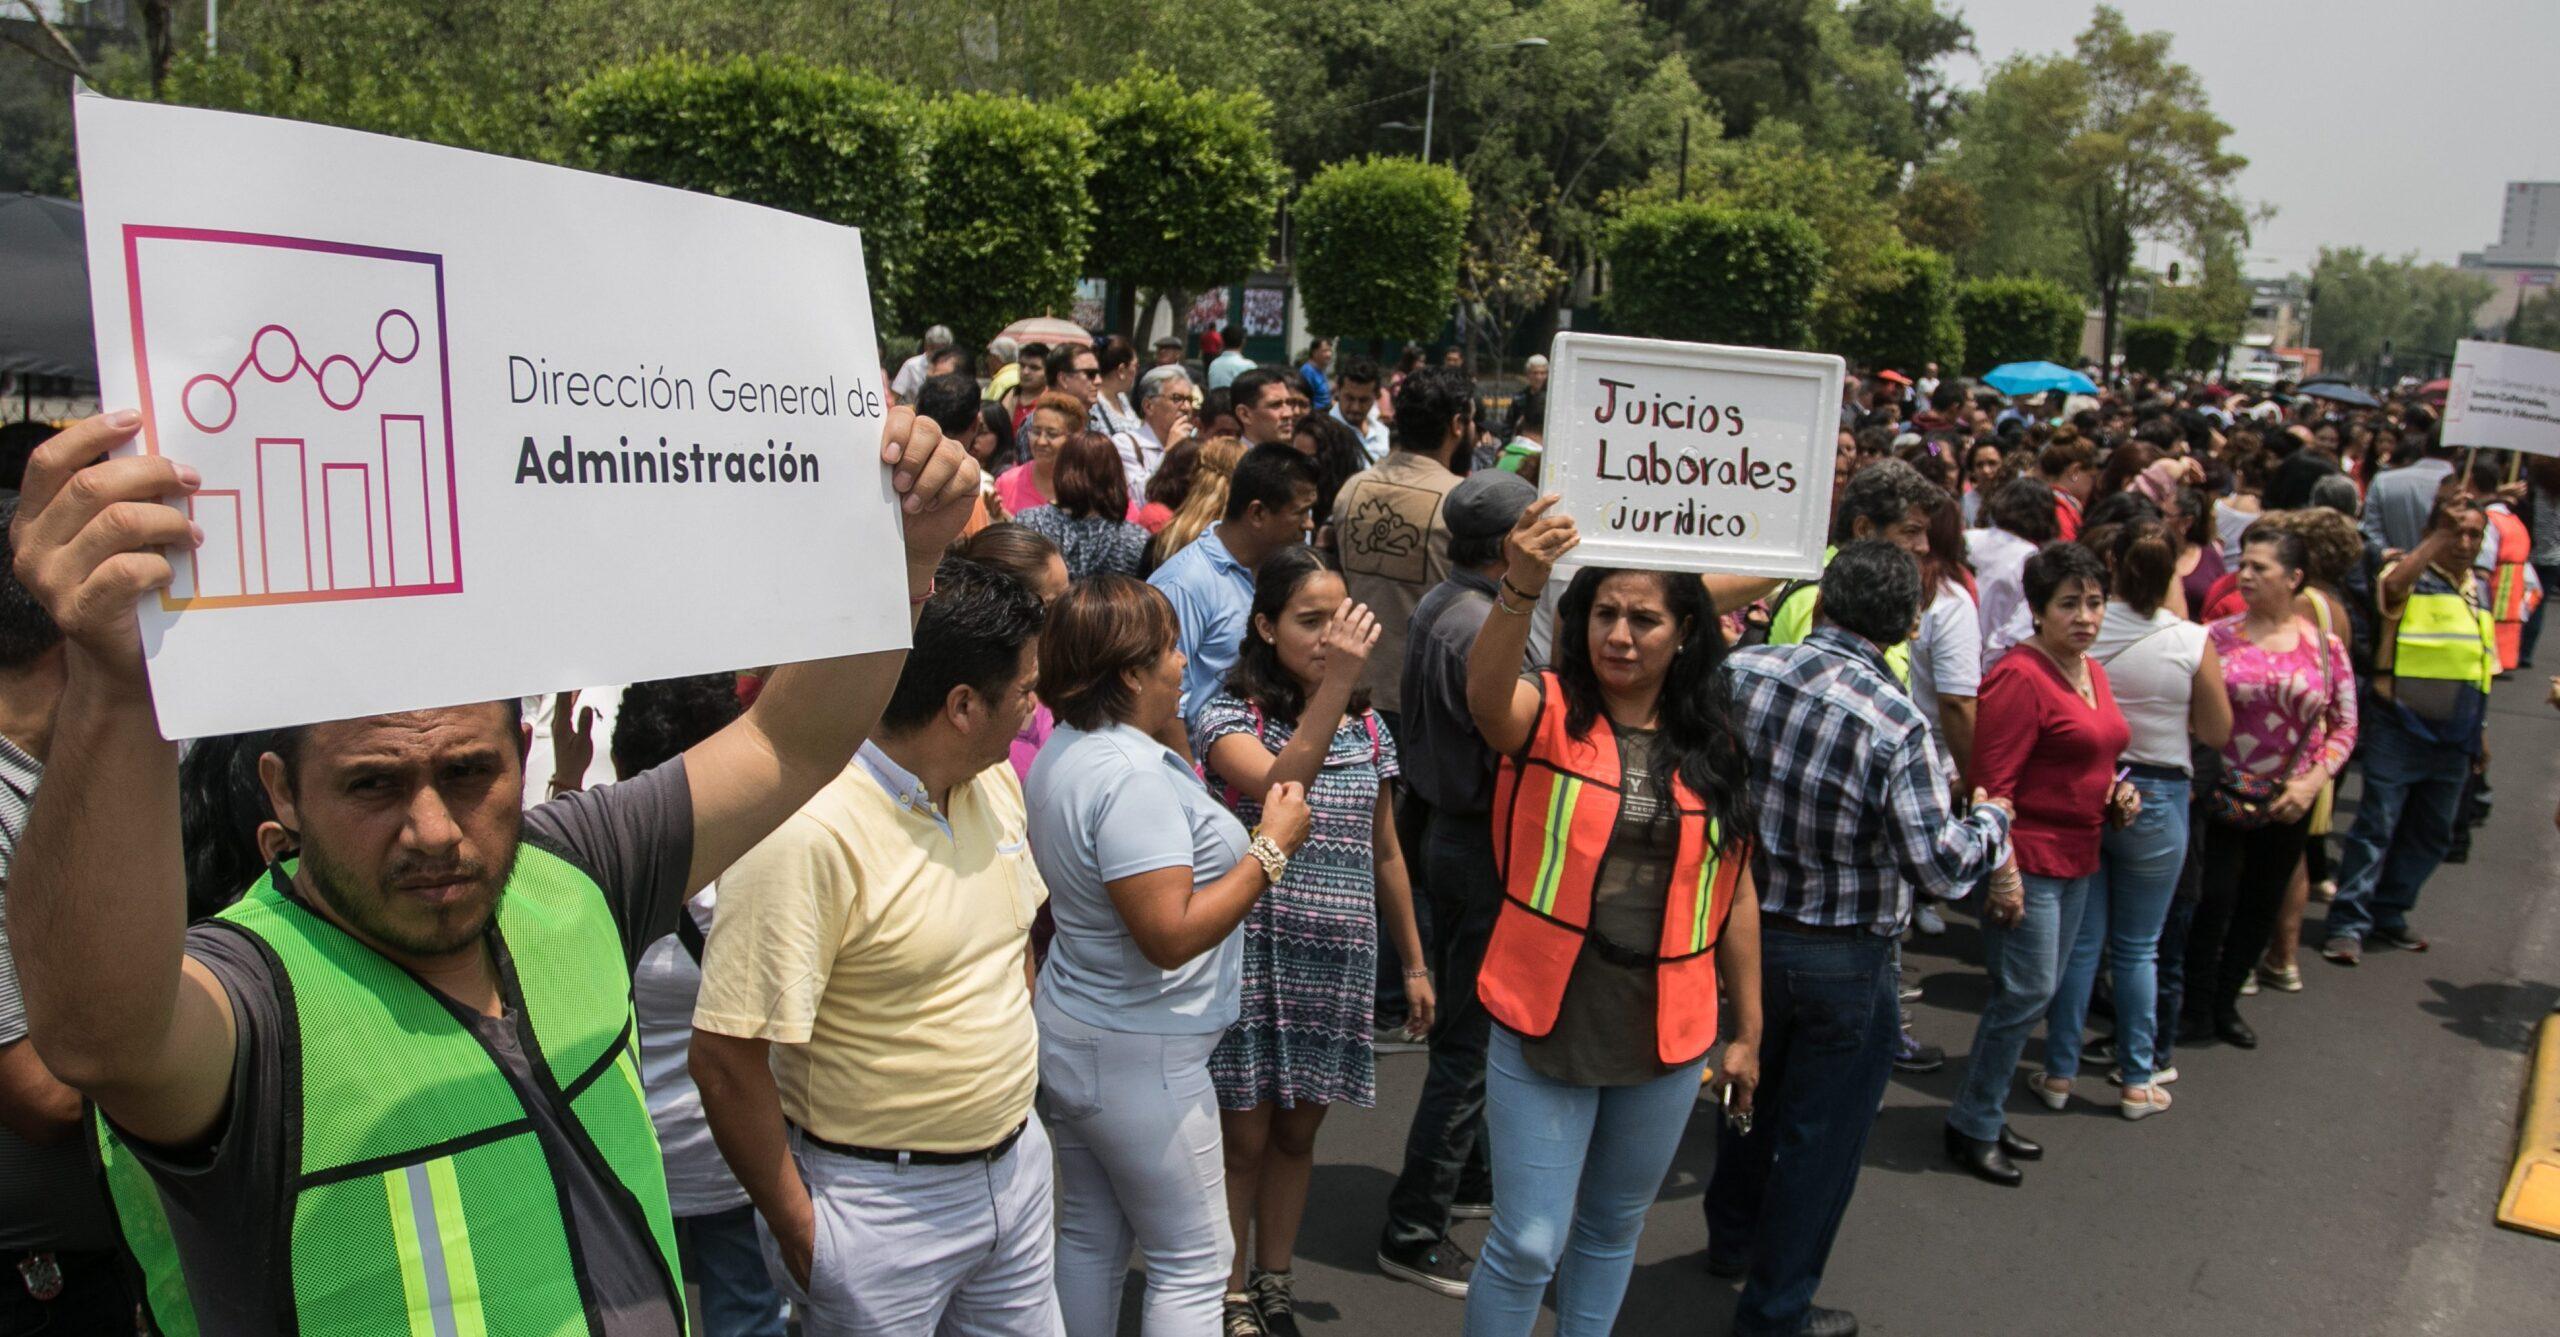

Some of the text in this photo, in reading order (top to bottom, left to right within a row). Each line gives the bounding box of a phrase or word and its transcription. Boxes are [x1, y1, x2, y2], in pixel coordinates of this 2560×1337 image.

[508, 355, 881, 418] Dirección General de
[1594, 377, 1745, 436] Juicios
[514, 434, 820, 485] Administración
[1596, 438, 1797, 494] Laborales
